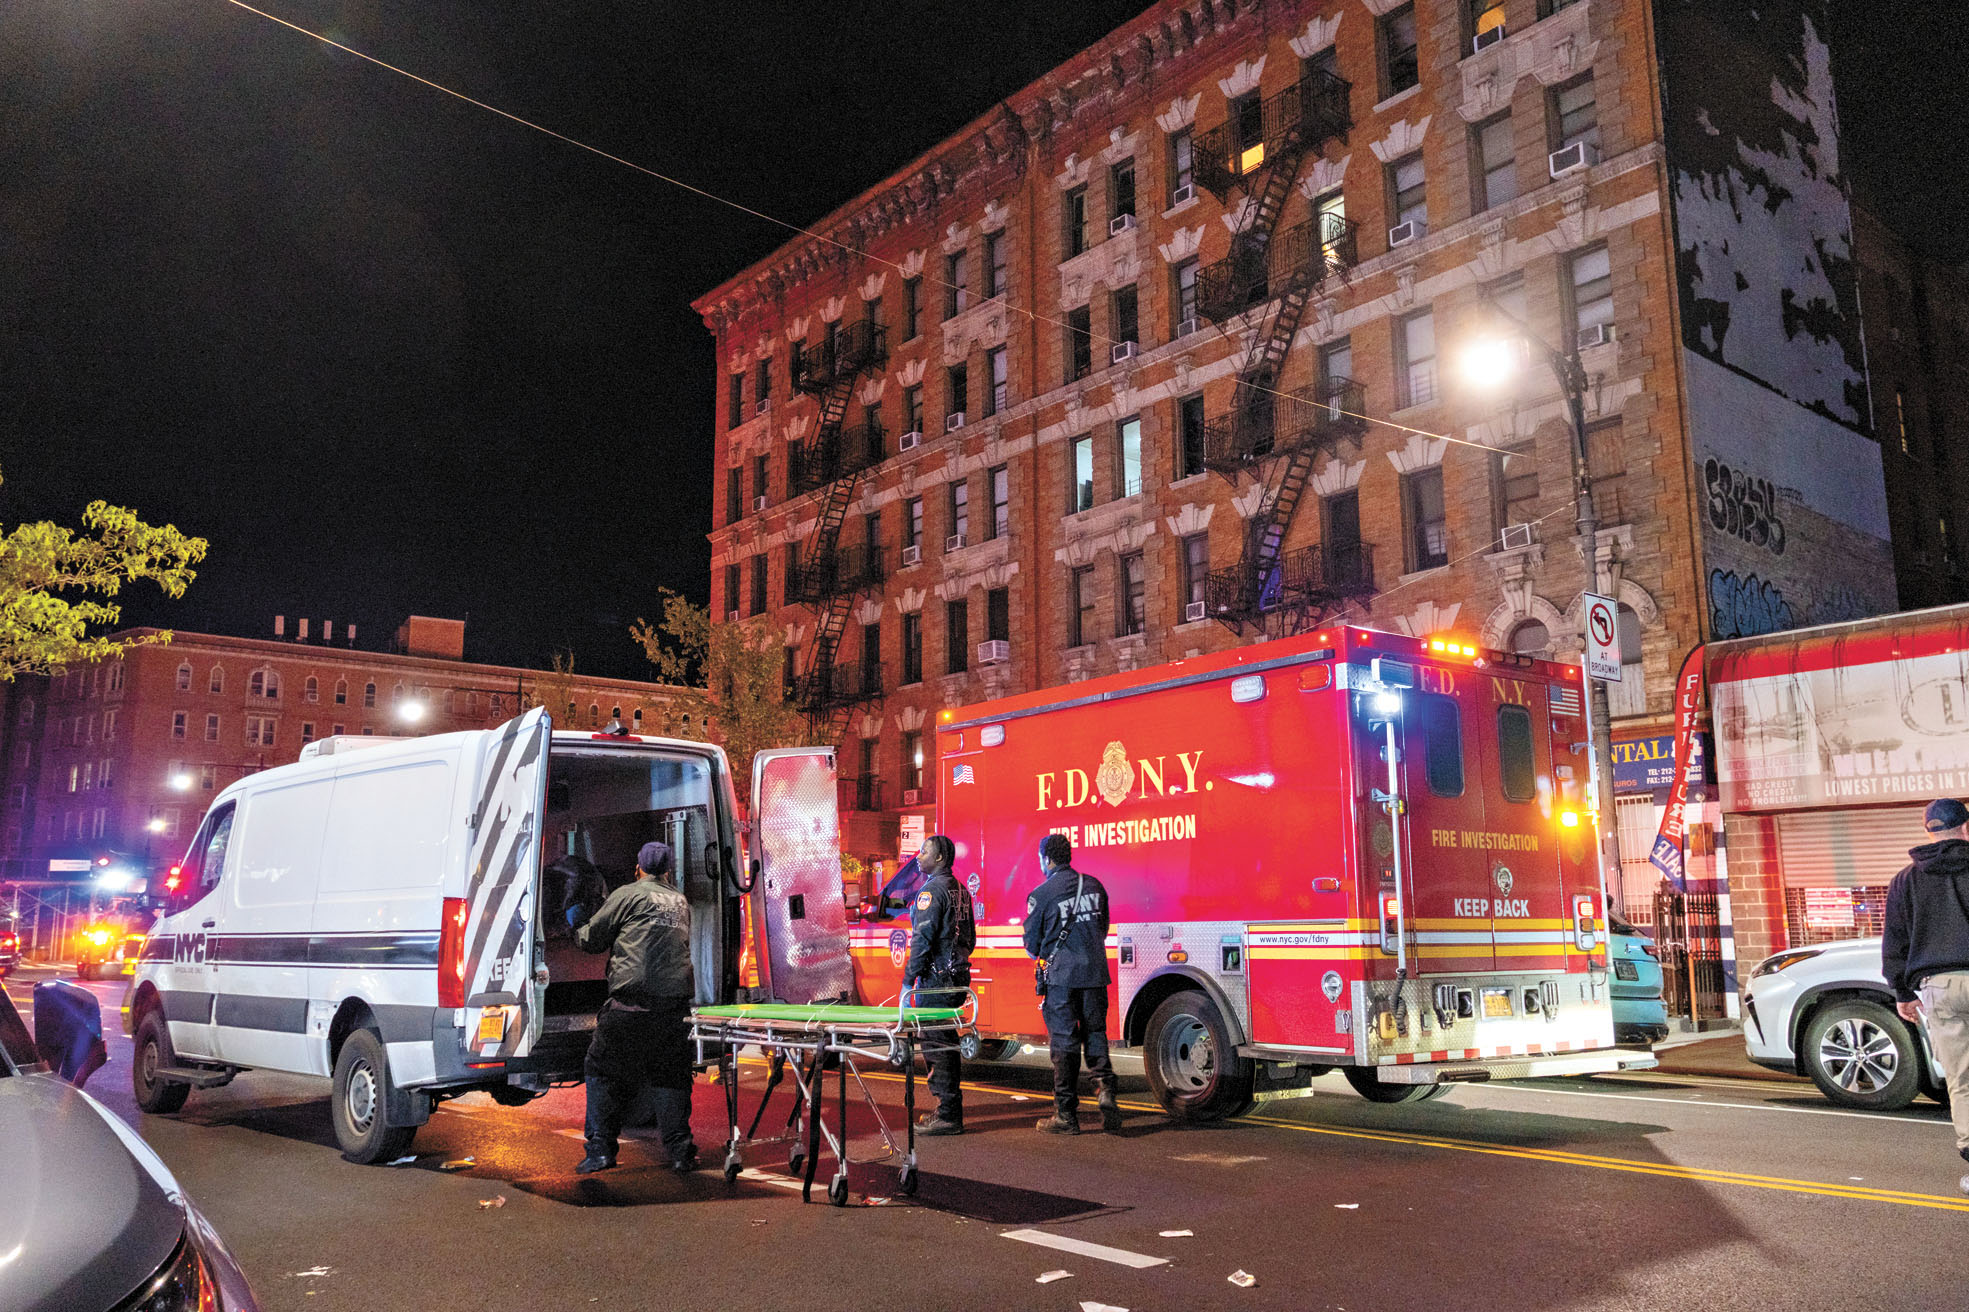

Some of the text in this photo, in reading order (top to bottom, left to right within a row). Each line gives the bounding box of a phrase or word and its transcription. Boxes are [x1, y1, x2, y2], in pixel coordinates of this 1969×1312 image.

[1600, 652, 1608, 661] AT
[1592, 662, 1618, 675] BROADWAY
[1420, 665, 1531, 706] F.D. N.Y.
[1611, 740, 1668, 764] NTAL
[1036, 750, 1214, 811] F.D. N.Y.
[1613, 780, 1637, 788] UROS
[1765, 779, 1796, 790] CREDIT
[1825, 770, 1969, 797] LOWEST PRICES IN T
[1748, 788, 1794, 798] NO CREDIT
[1737, 799, 1750, 807] NO
[1050, 814, 1196, 848] RE INVESTIGATION
[1432, 829, 1539, 852] FIRE INVESTIGATION
[1454, 898, 1530, 917] KEEP BACK
[174, 933, 206, 963] NYC
[1259, 934, 1330, 945] www.nyc.gov/fdny
